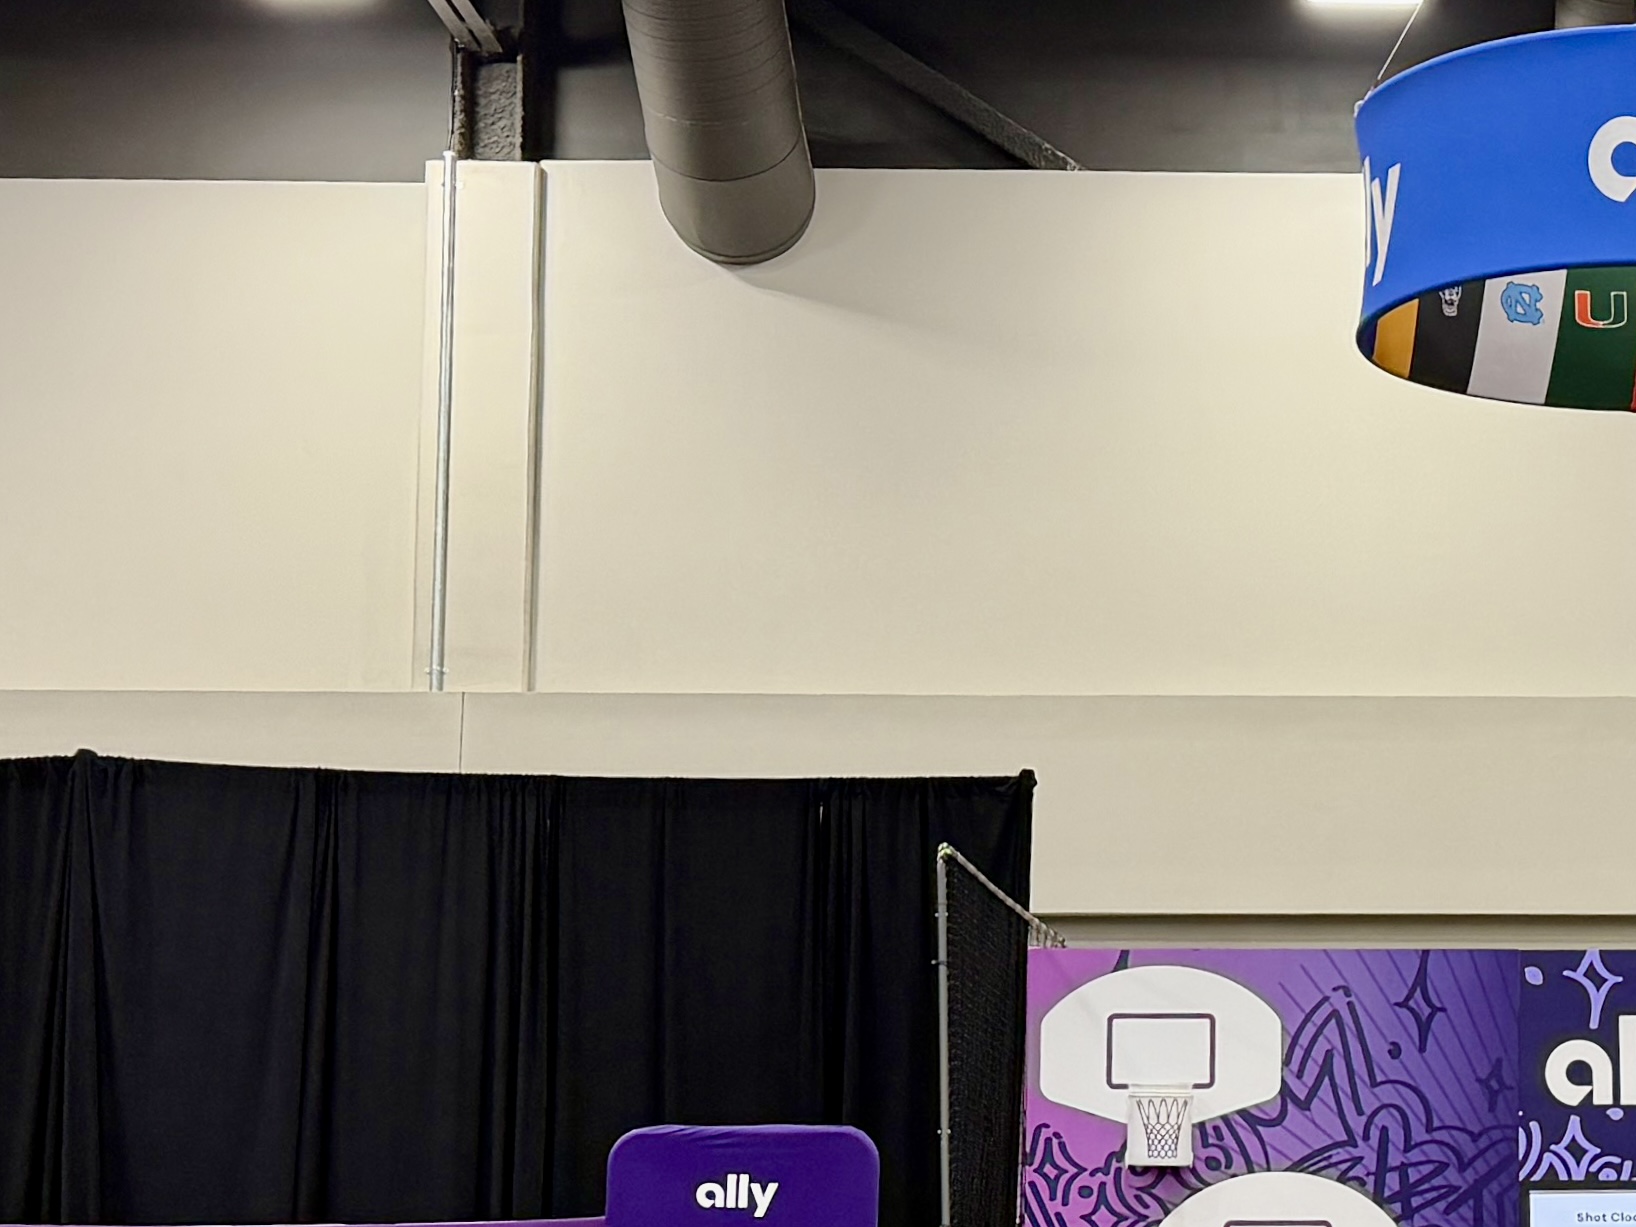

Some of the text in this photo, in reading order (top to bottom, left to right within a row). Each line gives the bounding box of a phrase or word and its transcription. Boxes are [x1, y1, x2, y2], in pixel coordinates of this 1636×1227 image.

[1363, 156, 1401, 287] ly
[695, 1173, 779, 1218] ally
[1577, 1212, 1607, 1223] Shot
